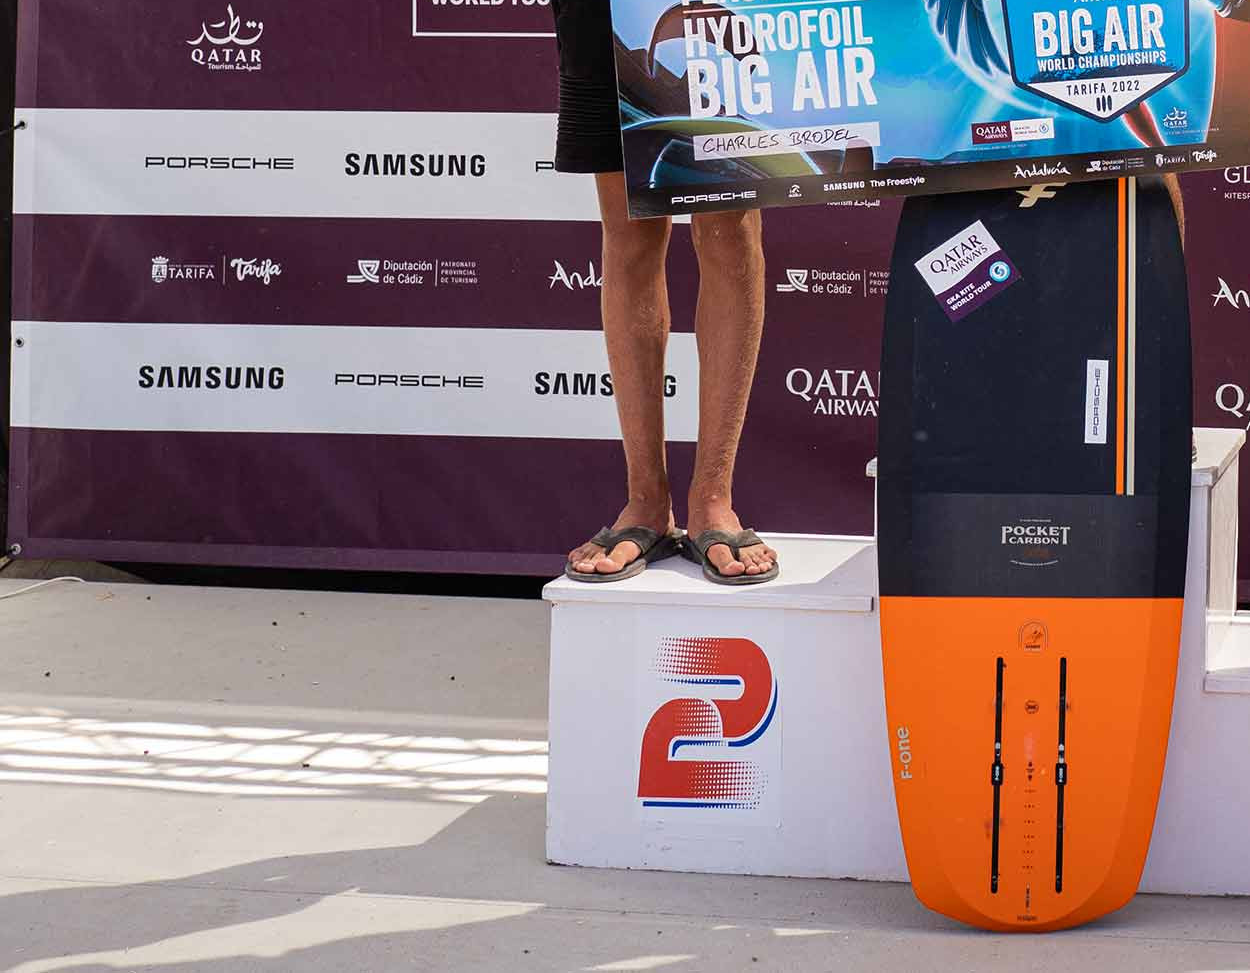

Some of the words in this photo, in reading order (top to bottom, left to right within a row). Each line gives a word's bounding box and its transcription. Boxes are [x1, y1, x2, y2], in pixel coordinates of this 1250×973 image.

[683, 6, 873, 58] HYDROFOIL
[1033, 9, 1094, 58] BIG
[1103, 3, 1166, 53] AIR
[191, 48, 262, 65] QATAR
[1038, 57, 1075, 72] WORLD
[1078, 50, 1166, 69] CHAMPIONSHIPS
[687, 54, 773, 119] BIG
[792, 47, 878, 111] AIR
[1066, 84, 1106, 96] TARIFA
[1113, 80, 1140, 92] 2022
[702, 134, 779, 152] CHARLES
[790, 128, 858, 147] BRODEL
[976, 125, 1007, 136] QATAR
[145, 156, 294, 170] PORSCHE
[345, 153, 486, 177] SAMSUNG
[1014, 162, 1071, 179] Andalucía
[672, 190, 757, 205] PORSCHE
[824, 181, 865, 191] SAMSUNG
[870, 179, 885, 187] The
[887, 177, 925, 186] Freestyle
[930, 234, 982, 273] QATAR
[950, 245, 988, 274] AIRWAYS
[169, 268, 214, 279] TARIFA
[230, 257, 282, 285] Tarifa
[383, 260, 433, 273] Diputación
[812, 270, 860, 281] Diputación
[383, 274, 395, 284] de
[397, 273, 423, 285] Cádiz
[812, 284, 823, 293] de
[827, 284, 852, 294] Cádiz
[946, 292, 961, 305] GKA
[960, 283, 975, 296] KITE
[950, 294, 974, 311] WORLD
[975, 280, 992, 295] TOUR
[138, 365, 285, 390] SAMSUNG
[335, 374, 484, 388] PORSCHE
[785, 368, 881, 400] QATA
[813, 398, 880, 417] AIRWA
[1093, 368, 1101, 435] PORSCHE
[1001, 526, 1070, 545] POCKET
[637, 636, 778, 810] 2
[897, 726, 912, 780] F-one
